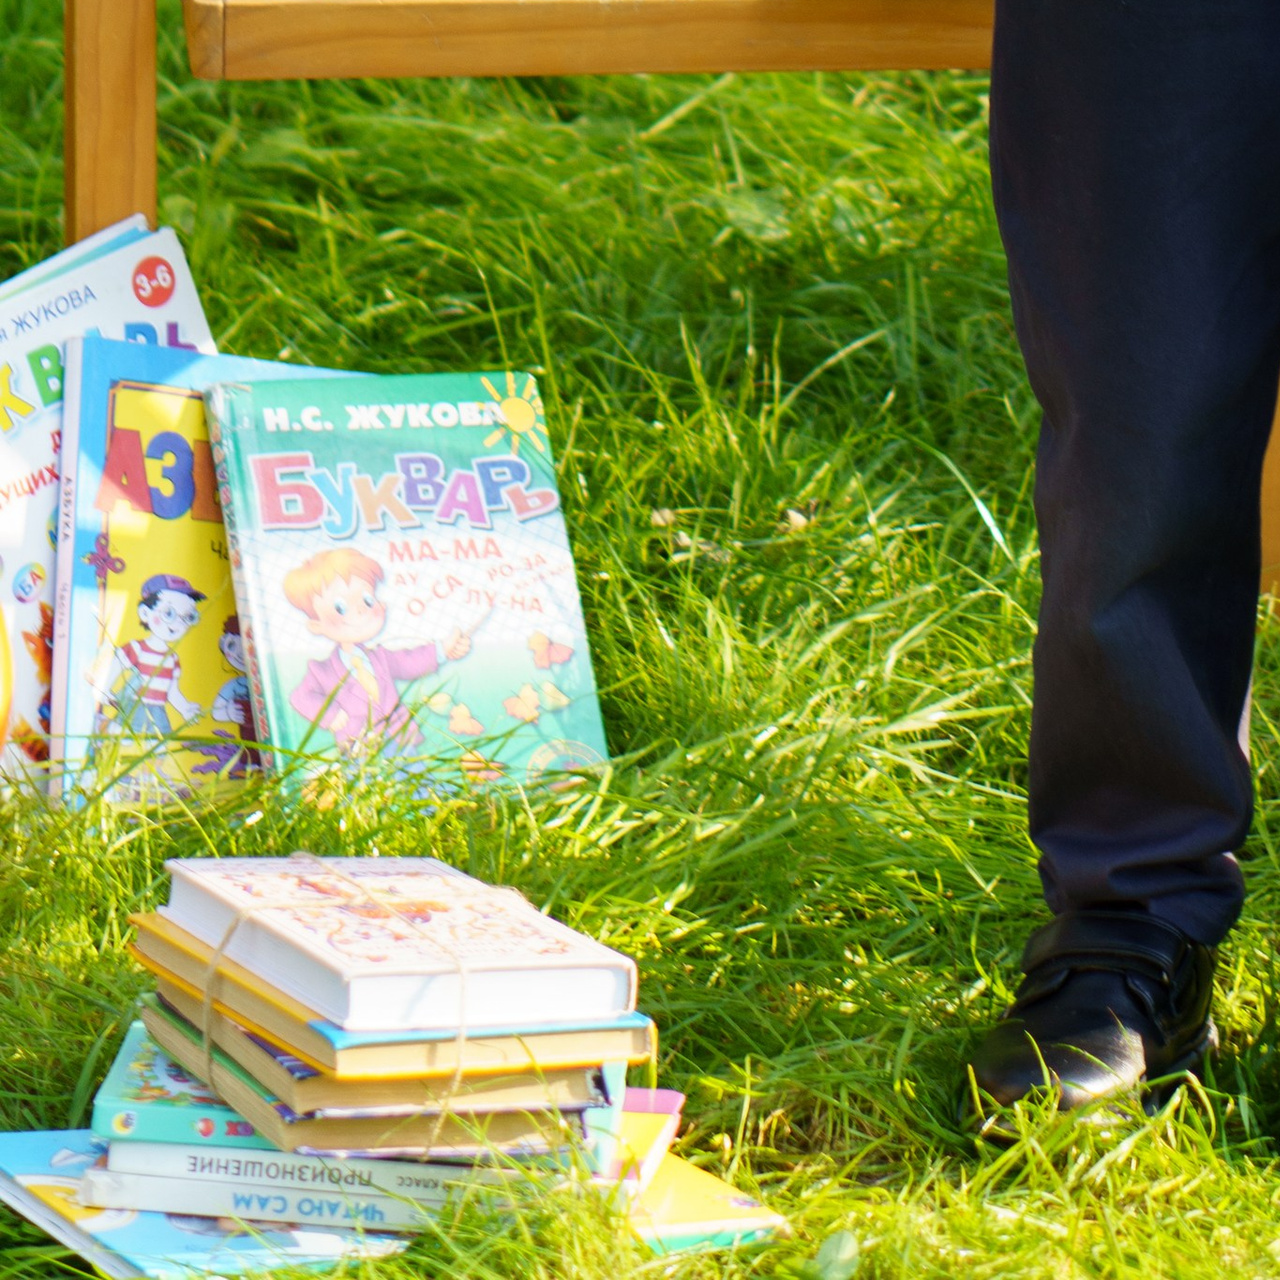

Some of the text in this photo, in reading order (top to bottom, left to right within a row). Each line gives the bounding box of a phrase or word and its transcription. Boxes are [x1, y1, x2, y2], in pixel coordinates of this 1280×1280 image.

[134, 264, 173, 298] 3-6
[10, 285, 98, 336] ЖУКОВА
[344, 401, 508, 430] ЖУКОВА
[388, 537, 503, 562] МА-МА
[187, 1153, 373, 1187] ПРОИЗНОШЕНИЕ
[232, 1192, 288, 1215] САМ
[299, 1197, 385, 1223] ЧИТАЮ
